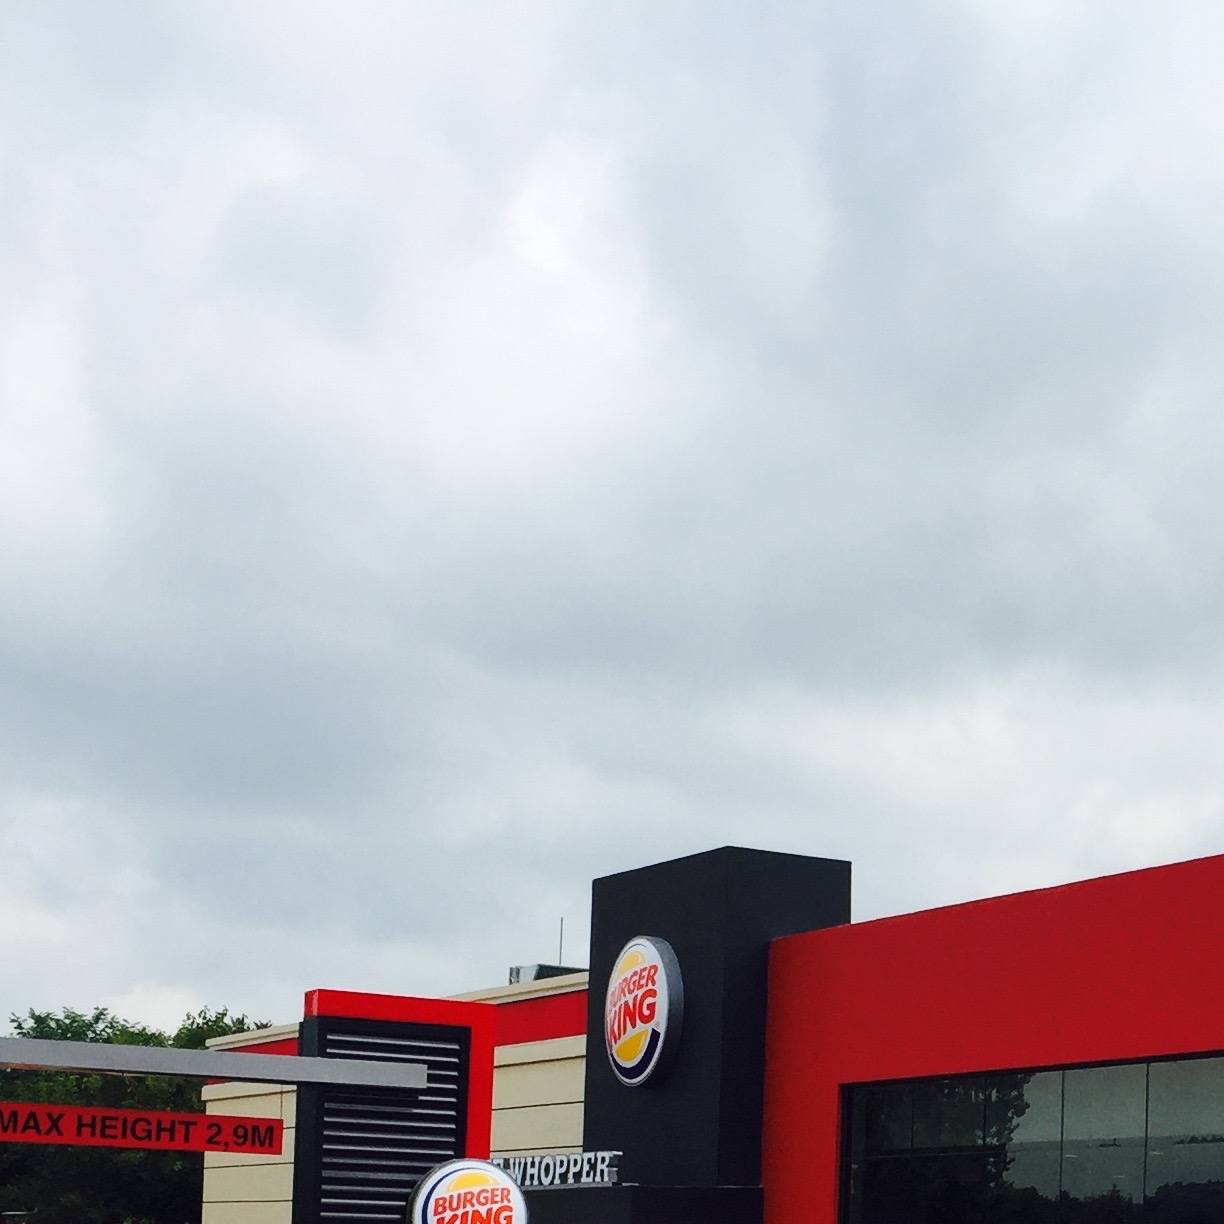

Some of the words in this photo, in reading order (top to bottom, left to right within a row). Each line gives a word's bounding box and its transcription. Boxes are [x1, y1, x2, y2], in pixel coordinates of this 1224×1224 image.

[608, 988, 658, 1054] KING
[0, 1109, 65, 1137] MAX
[75, 1114, 197, 1144] HEIGHT
[205, 1122, 275, 1151] 2,9M
[509, 1151, 611, 1187] WHOPPER
[433, 1187, 512, 1217] BURGER
